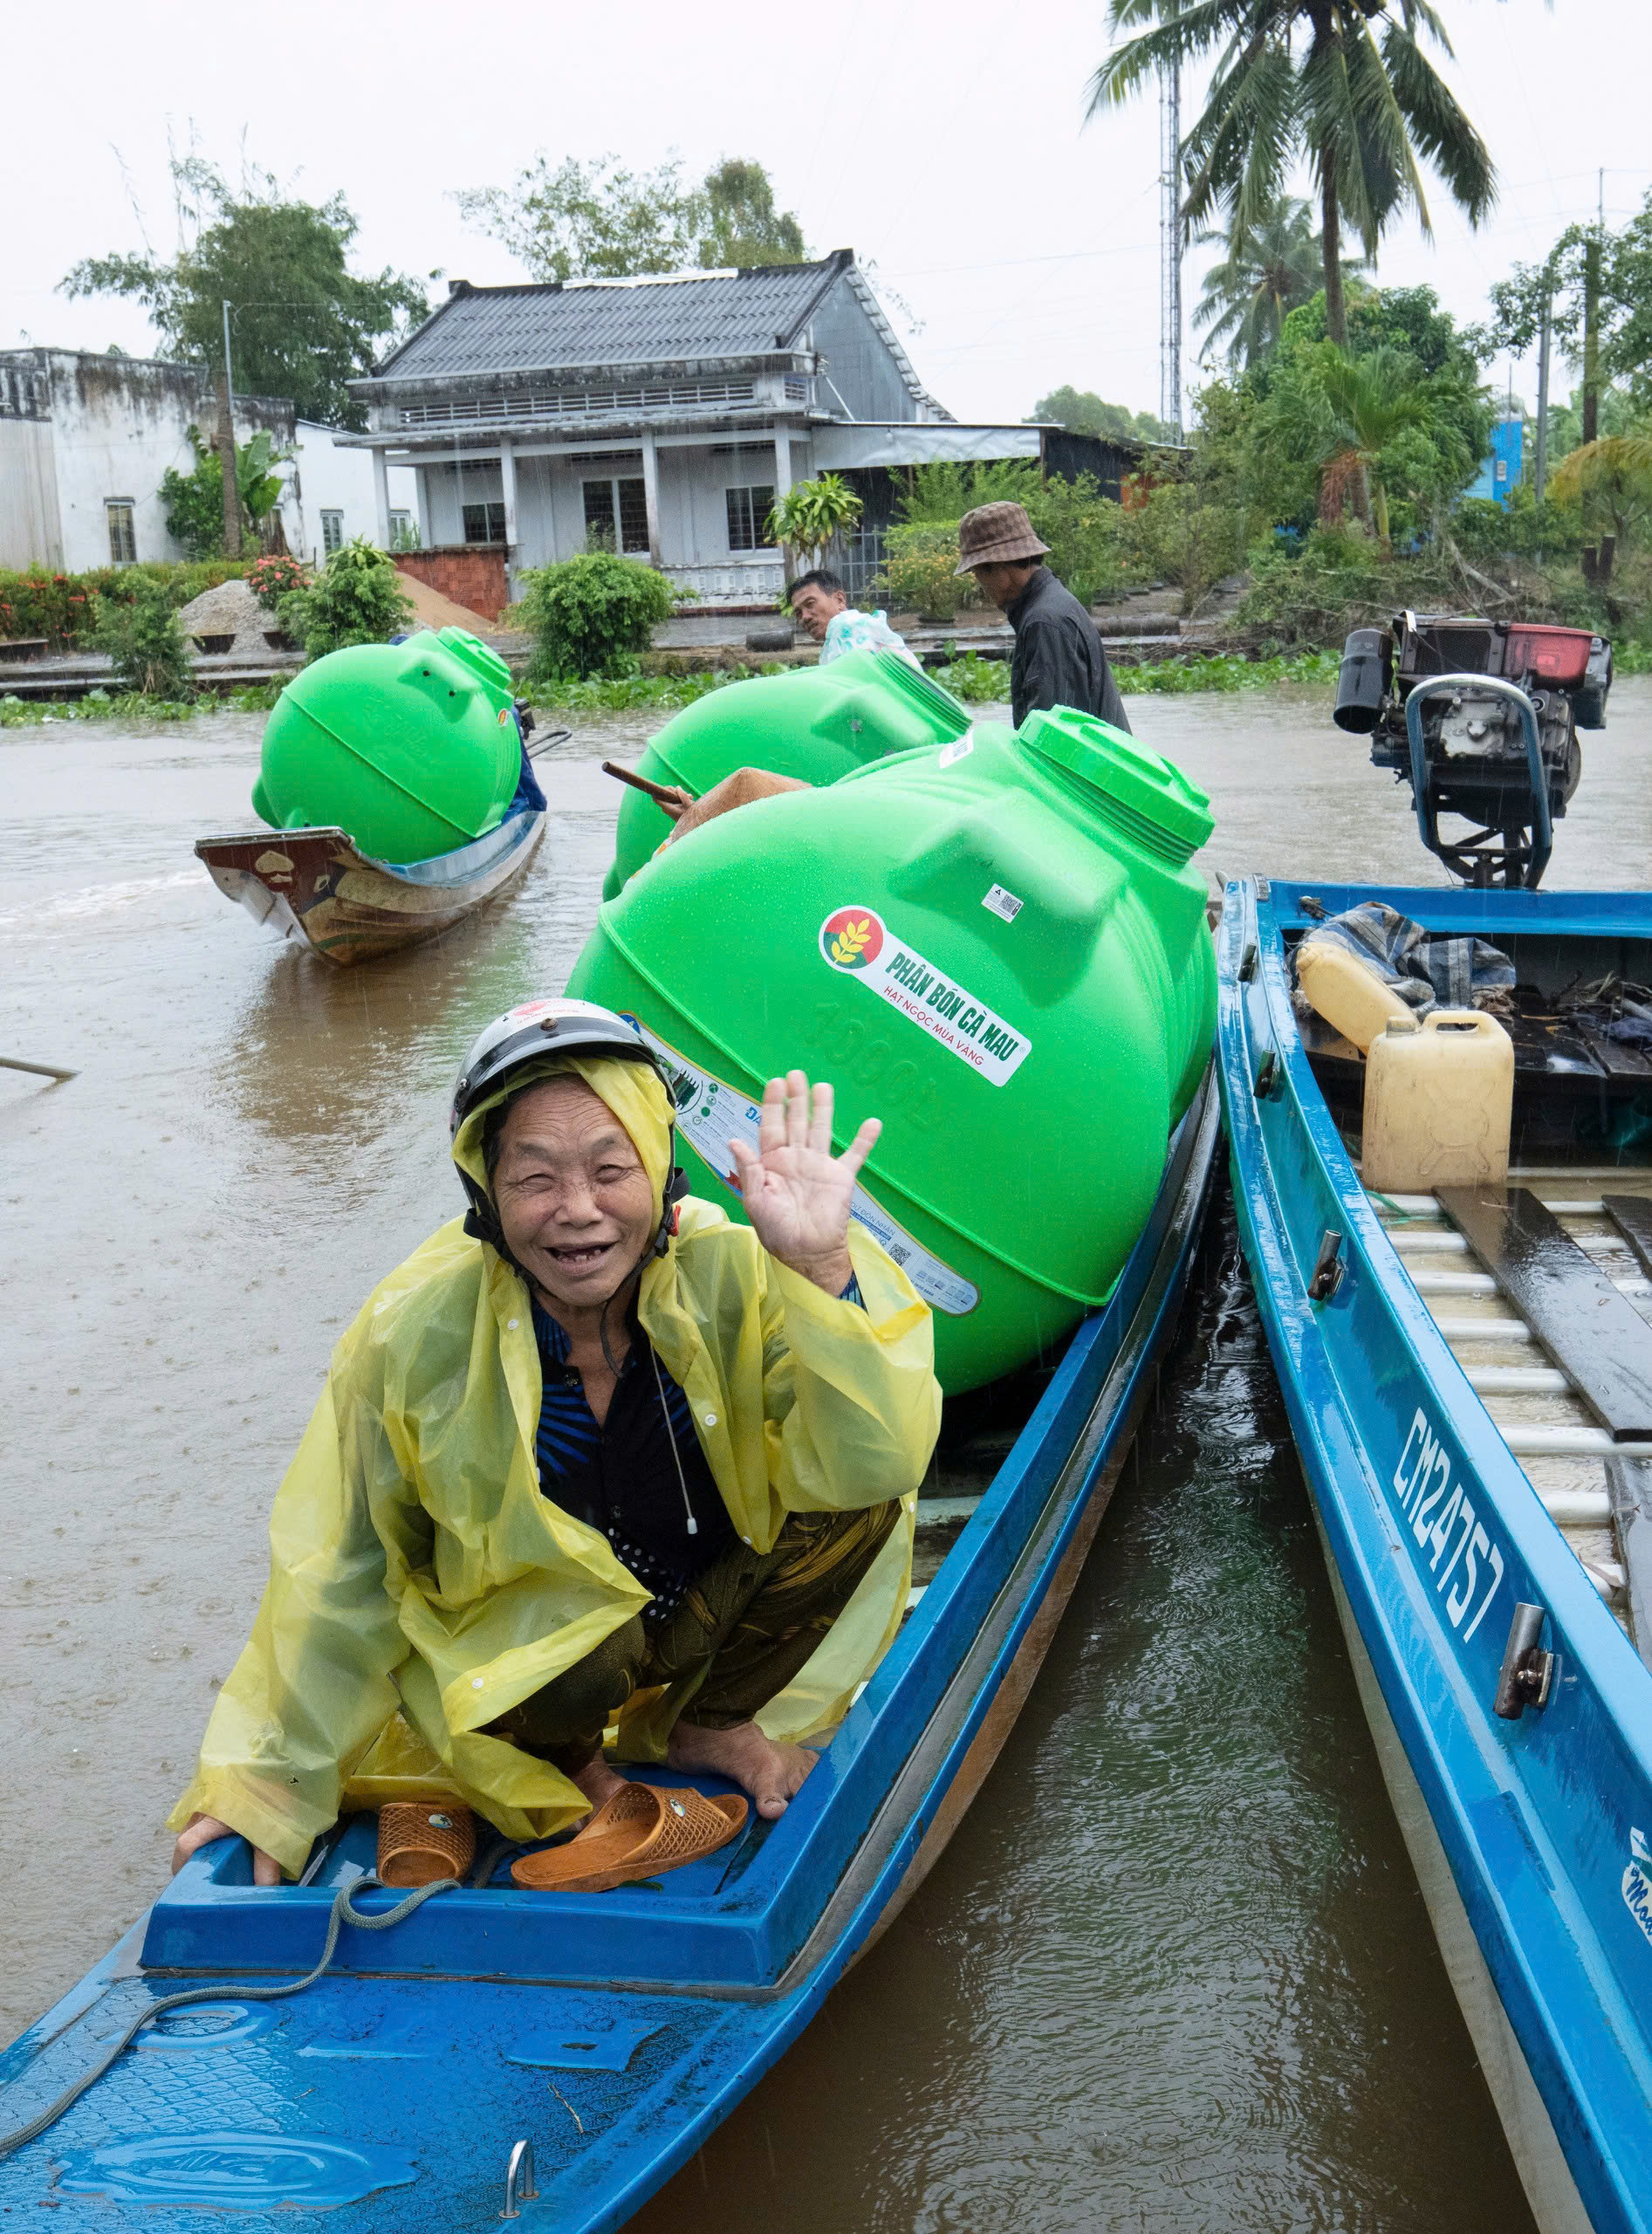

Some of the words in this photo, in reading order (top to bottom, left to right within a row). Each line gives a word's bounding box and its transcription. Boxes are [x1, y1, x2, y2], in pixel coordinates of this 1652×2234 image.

[883, 985, 904, 1004] HẠT
[901, 999, 934, 1027] NGỌC
[932, 1023, 956, 1045] MÙA
[956, 1039, 984, 1066] VÀNG
[885, 951, 936, 997] PHÂN
[925, 982, 966, 1021] BÓN
[957, 1006, 988, 1038] CÀ
[977, 1022, 1019, 1062] MAU
[1393, 1406, 1505, 1644] CM24757
